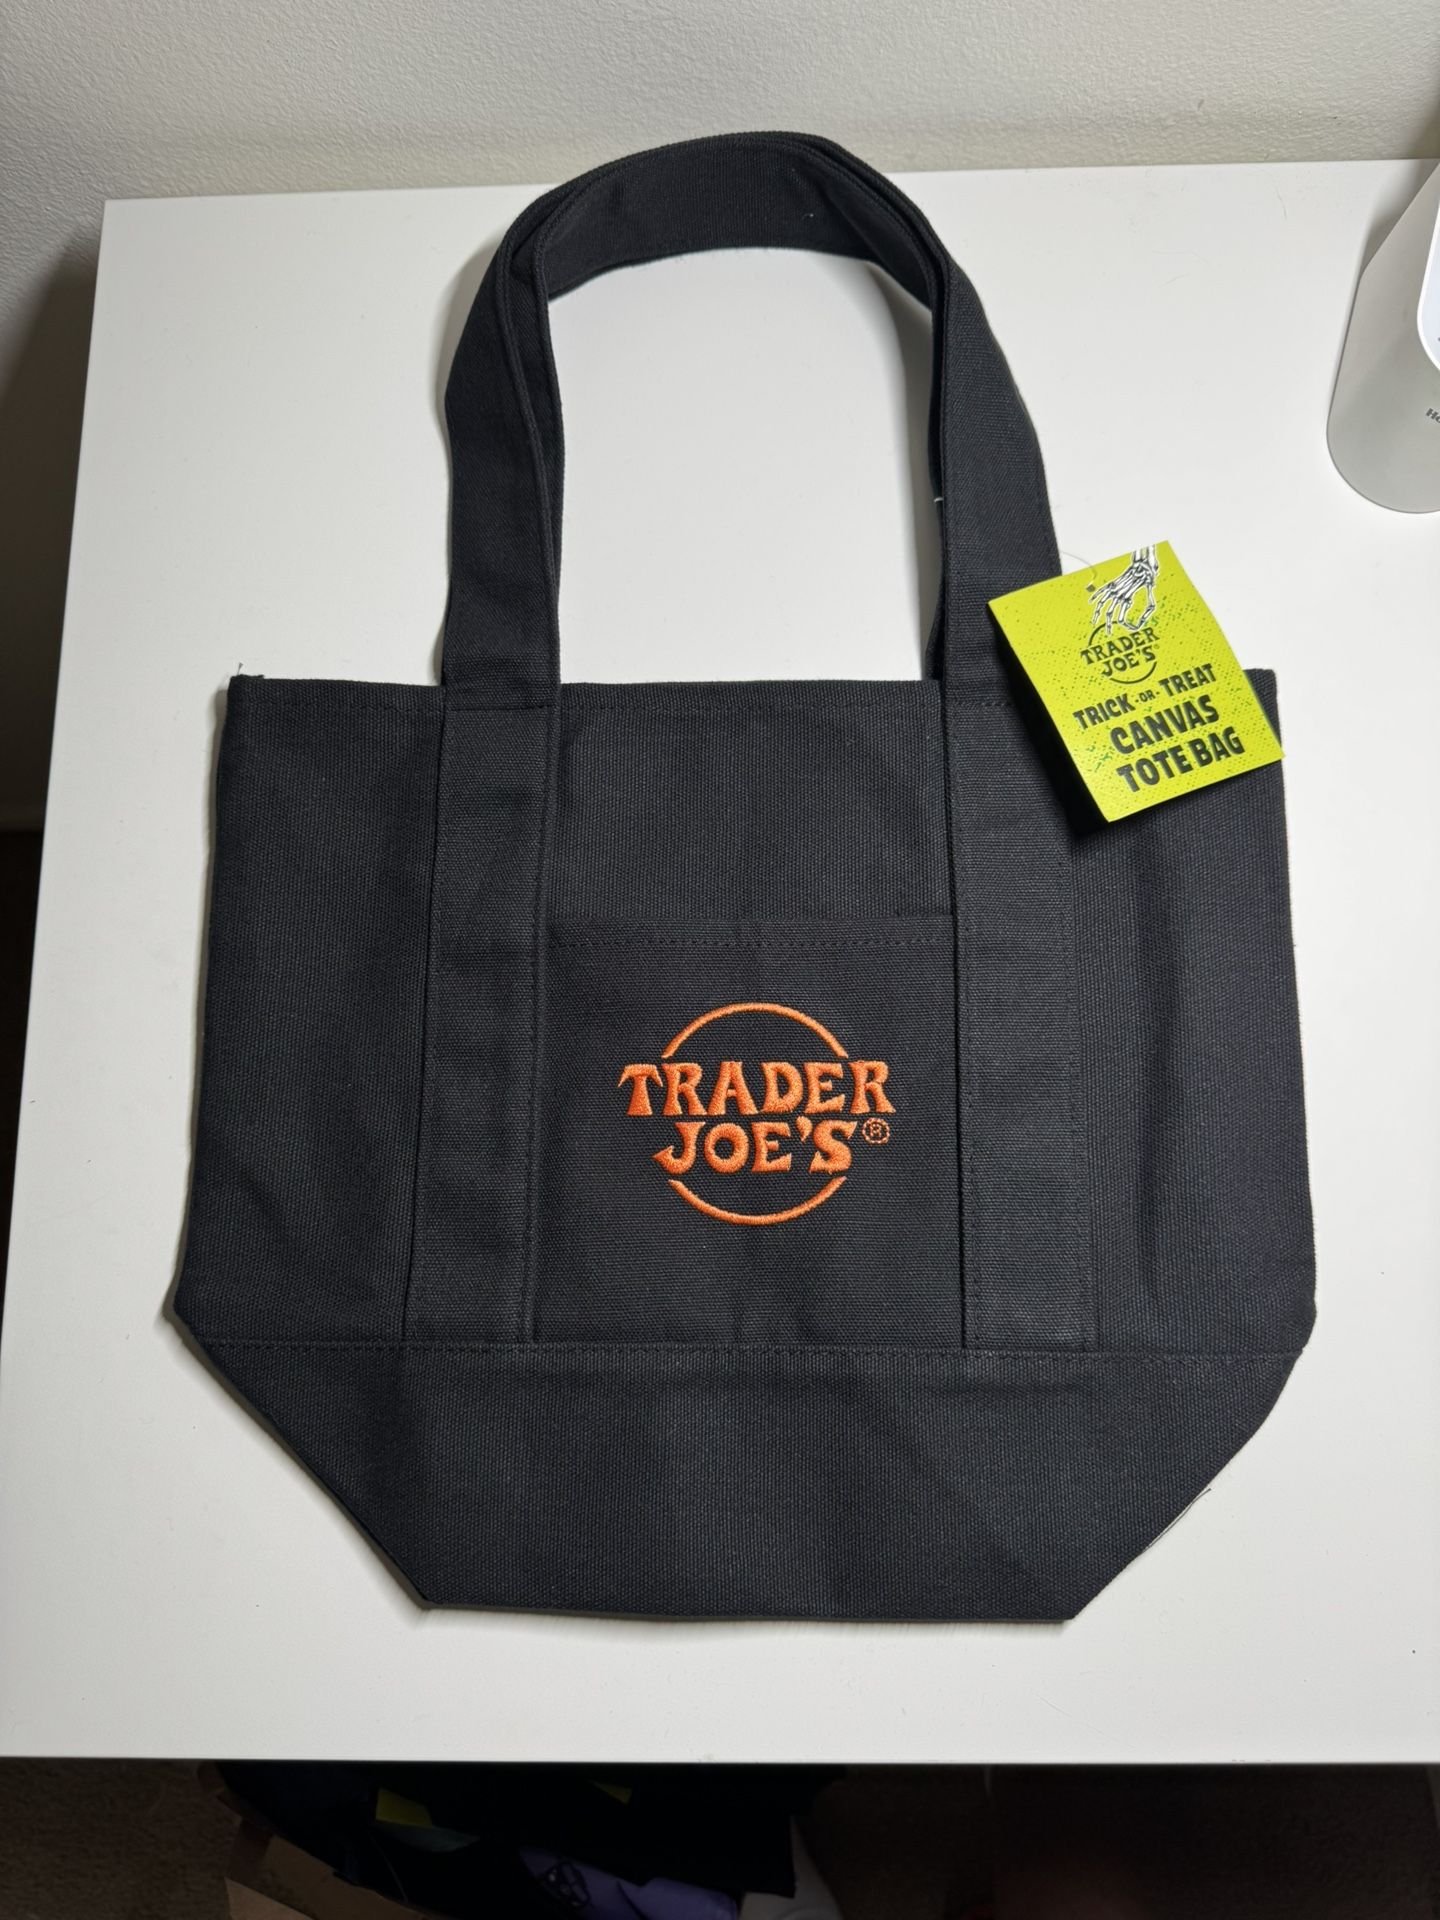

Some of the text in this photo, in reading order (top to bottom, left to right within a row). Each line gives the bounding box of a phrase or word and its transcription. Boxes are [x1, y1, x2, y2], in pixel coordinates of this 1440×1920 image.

[1080, 627, 1160, 665] TRADER
[1101, 646, 1156, 677] JOE'S
[1073, 693, 1136, 730] TRICK
[1158, 663, 1216, 697] TREAT
[1110, 695, 1220, 755] CANVAS
[1116, 726, 1245, 792] TOTE BAG
[617, 1060, 896, 1116] TRADER
[652, 1116, 858, 1174] JOE'S
